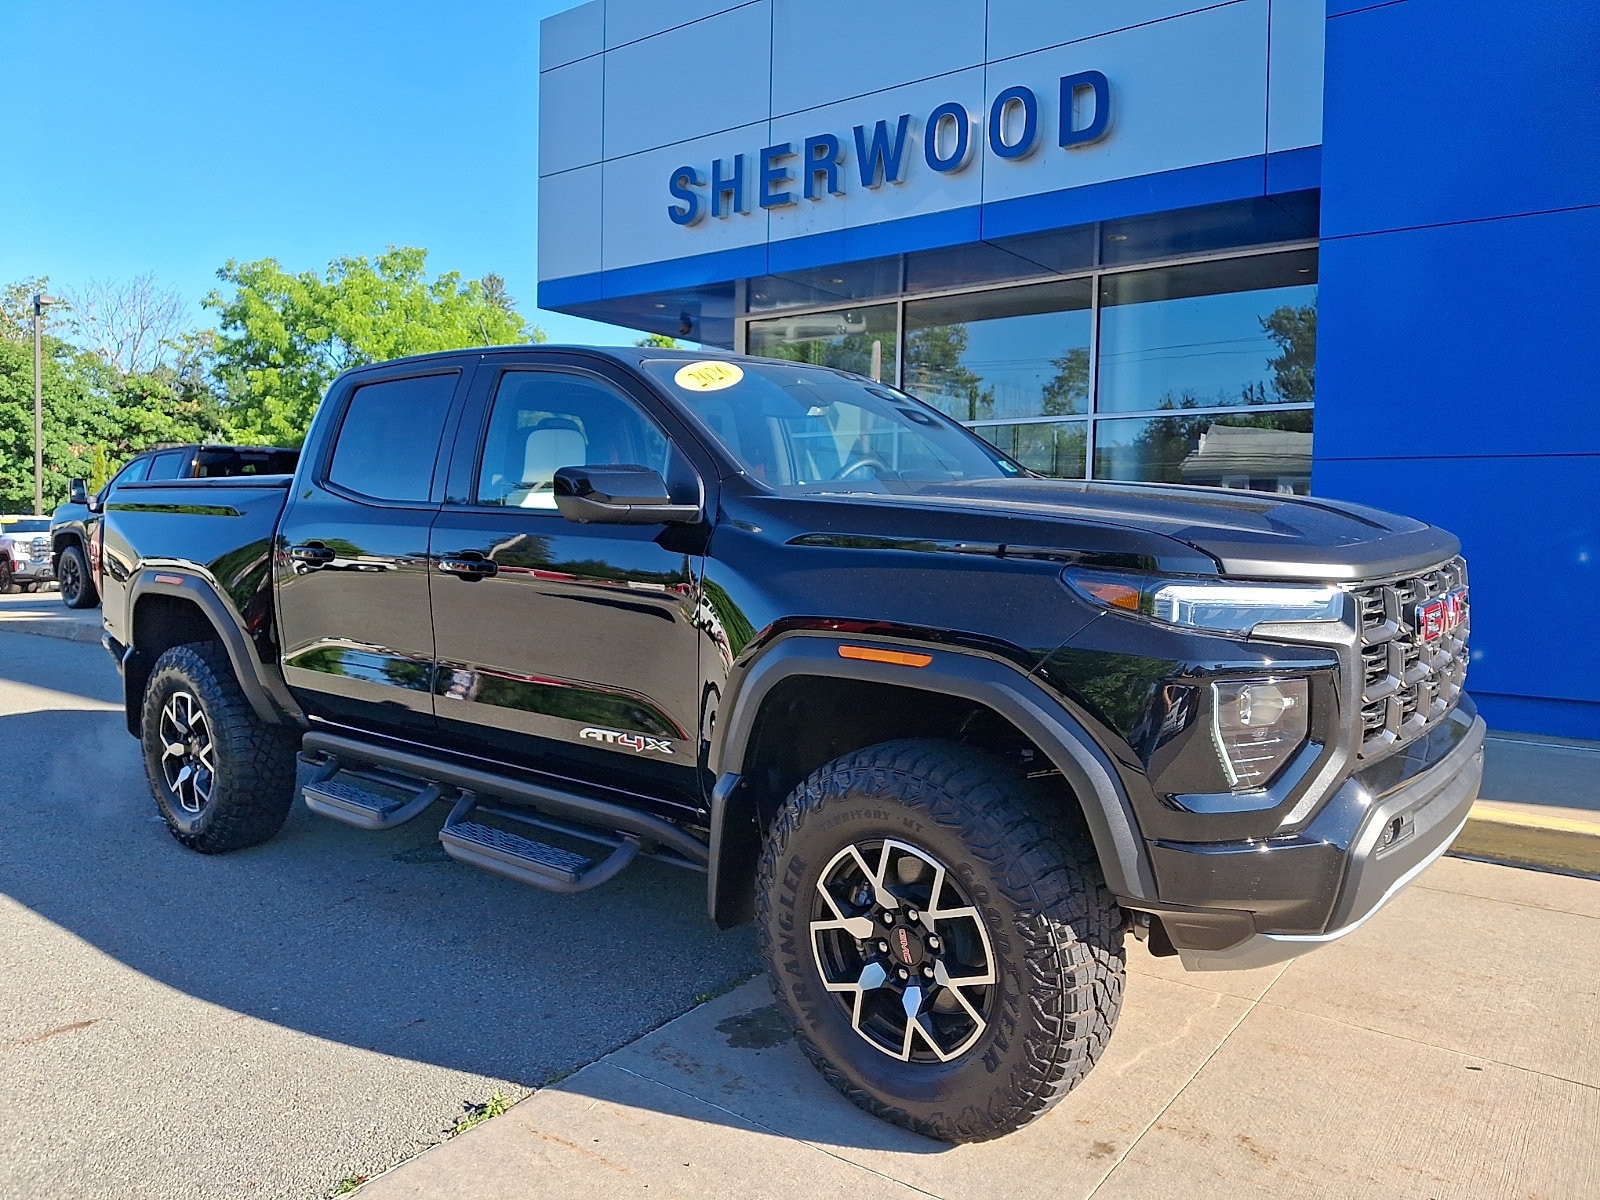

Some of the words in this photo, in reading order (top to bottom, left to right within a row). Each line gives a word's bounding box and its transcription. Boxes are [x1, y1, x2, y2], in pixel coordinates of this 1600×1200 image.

[667, 70, 1113, 227] SHERWOOD
[1416, 586, 1469, 642] GMC
[580, 727, 675, 754] AT4X
[898, 928, 913, 964] GMC
